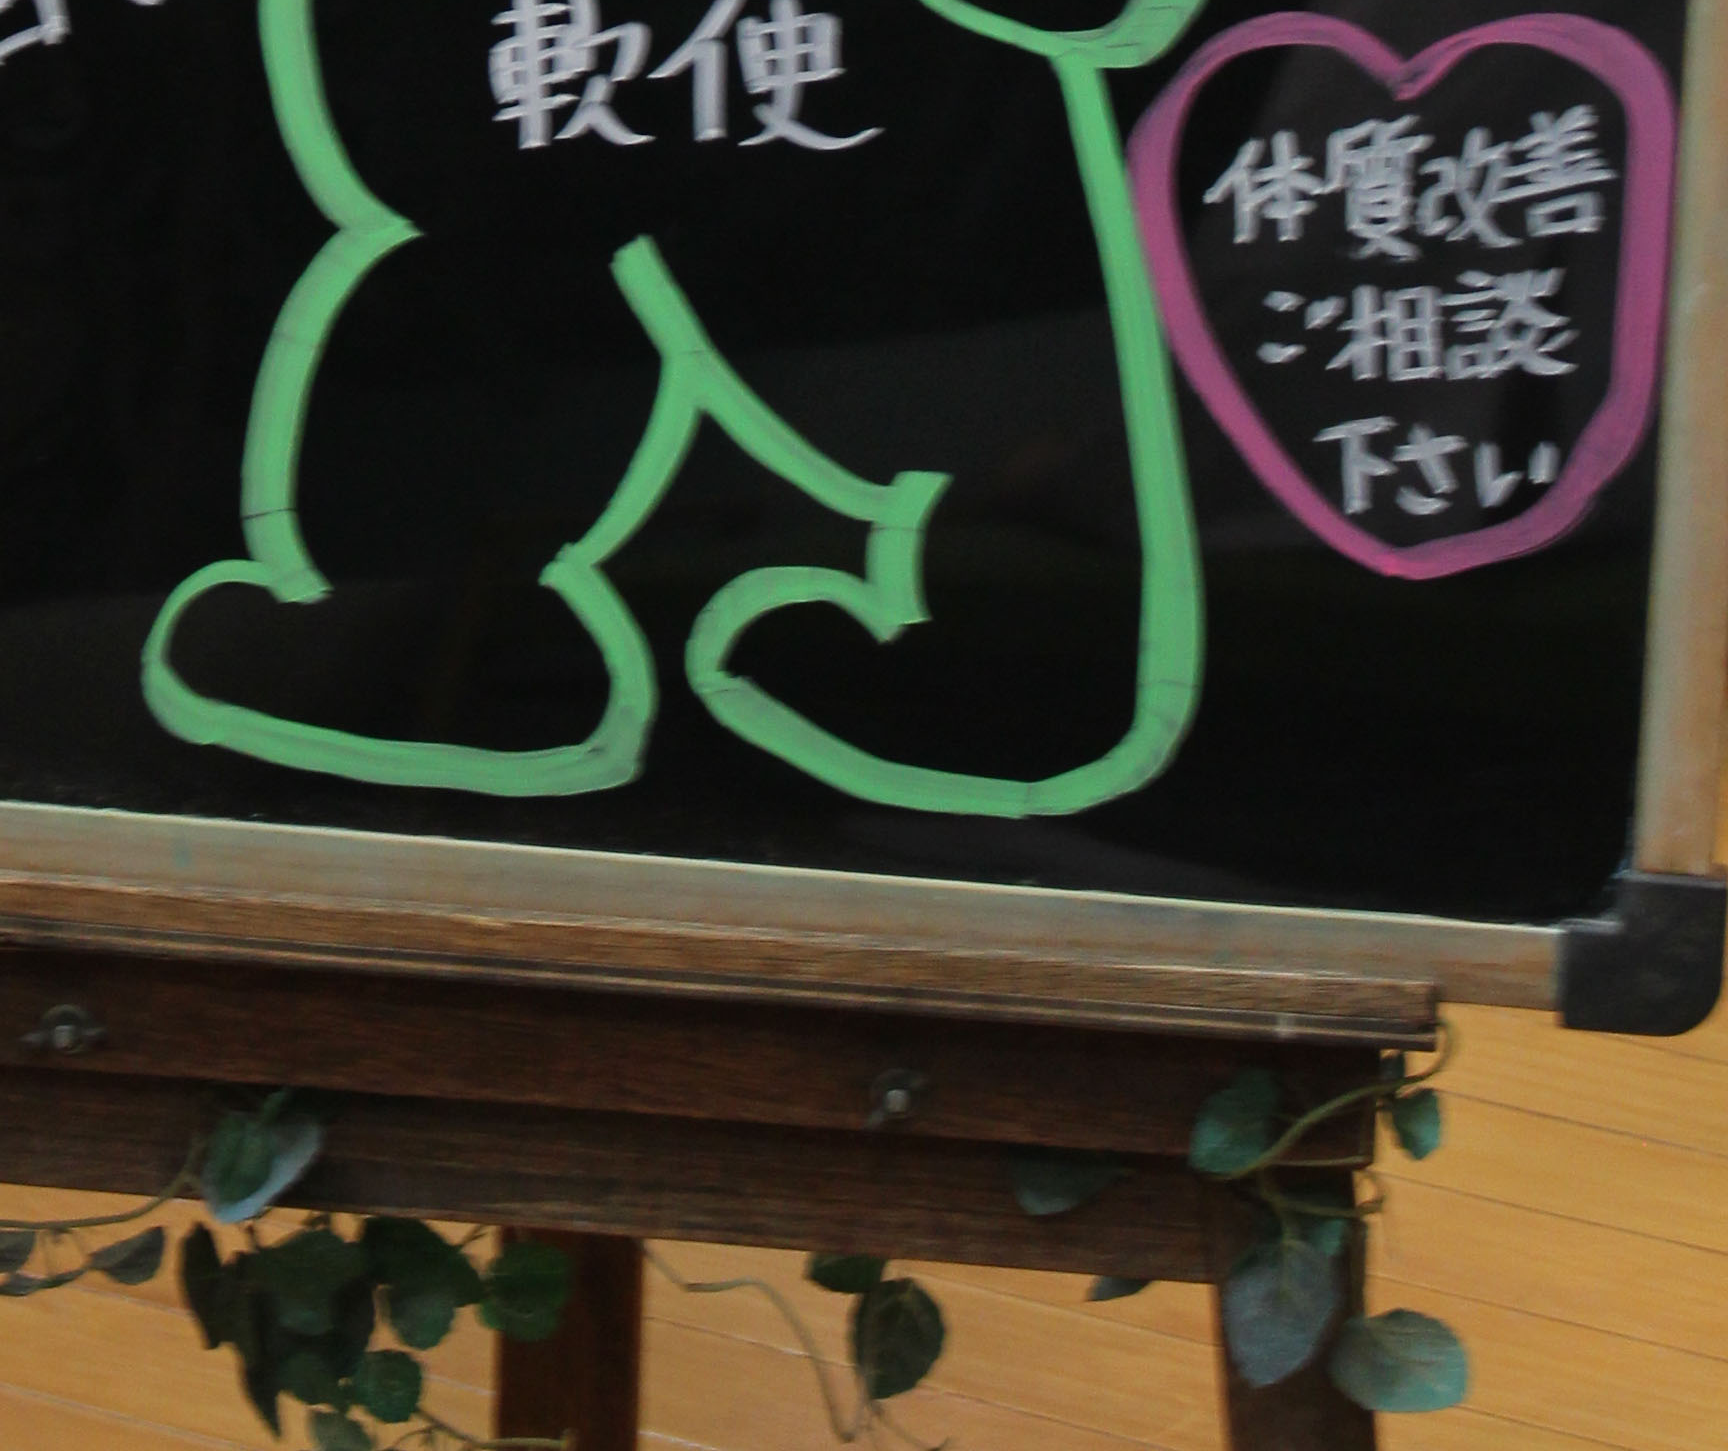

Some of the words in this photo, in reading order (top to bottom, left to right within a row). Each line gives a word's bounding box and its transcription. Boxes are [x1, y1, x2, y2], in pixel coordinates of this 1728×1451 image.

[1202, 104, 1619, 264] 体質改善
[1312, 416, 1563, 515] 下さい
